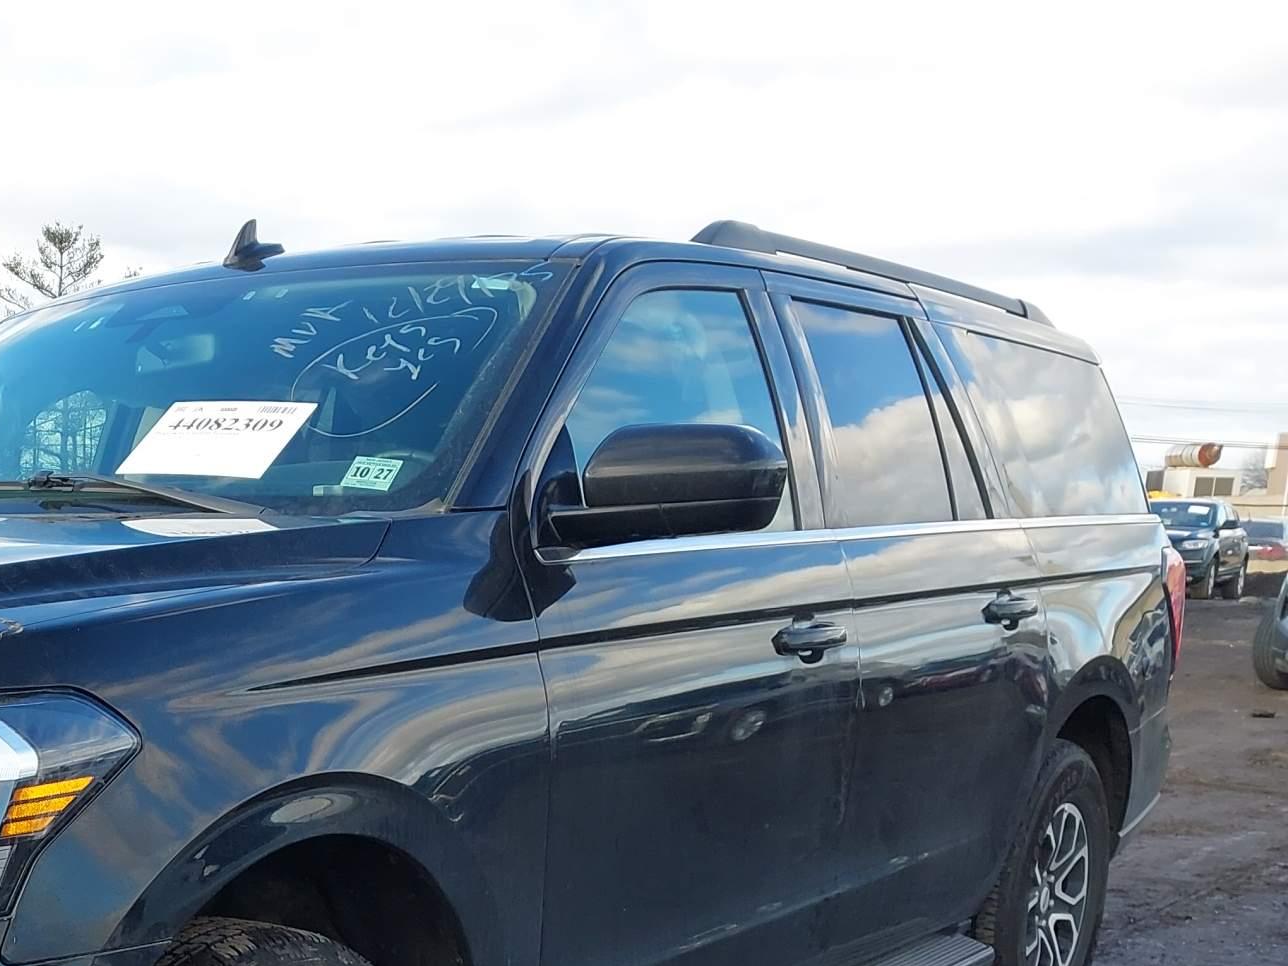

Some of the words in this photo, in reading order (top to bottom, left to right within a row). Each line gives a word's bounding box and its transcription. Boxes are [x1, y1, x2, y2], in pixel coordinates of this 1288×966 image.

[168, 417, 284, 433] 44082309
[350, 465, 371, 479] 10
[373, 467, 394, 481] 27
